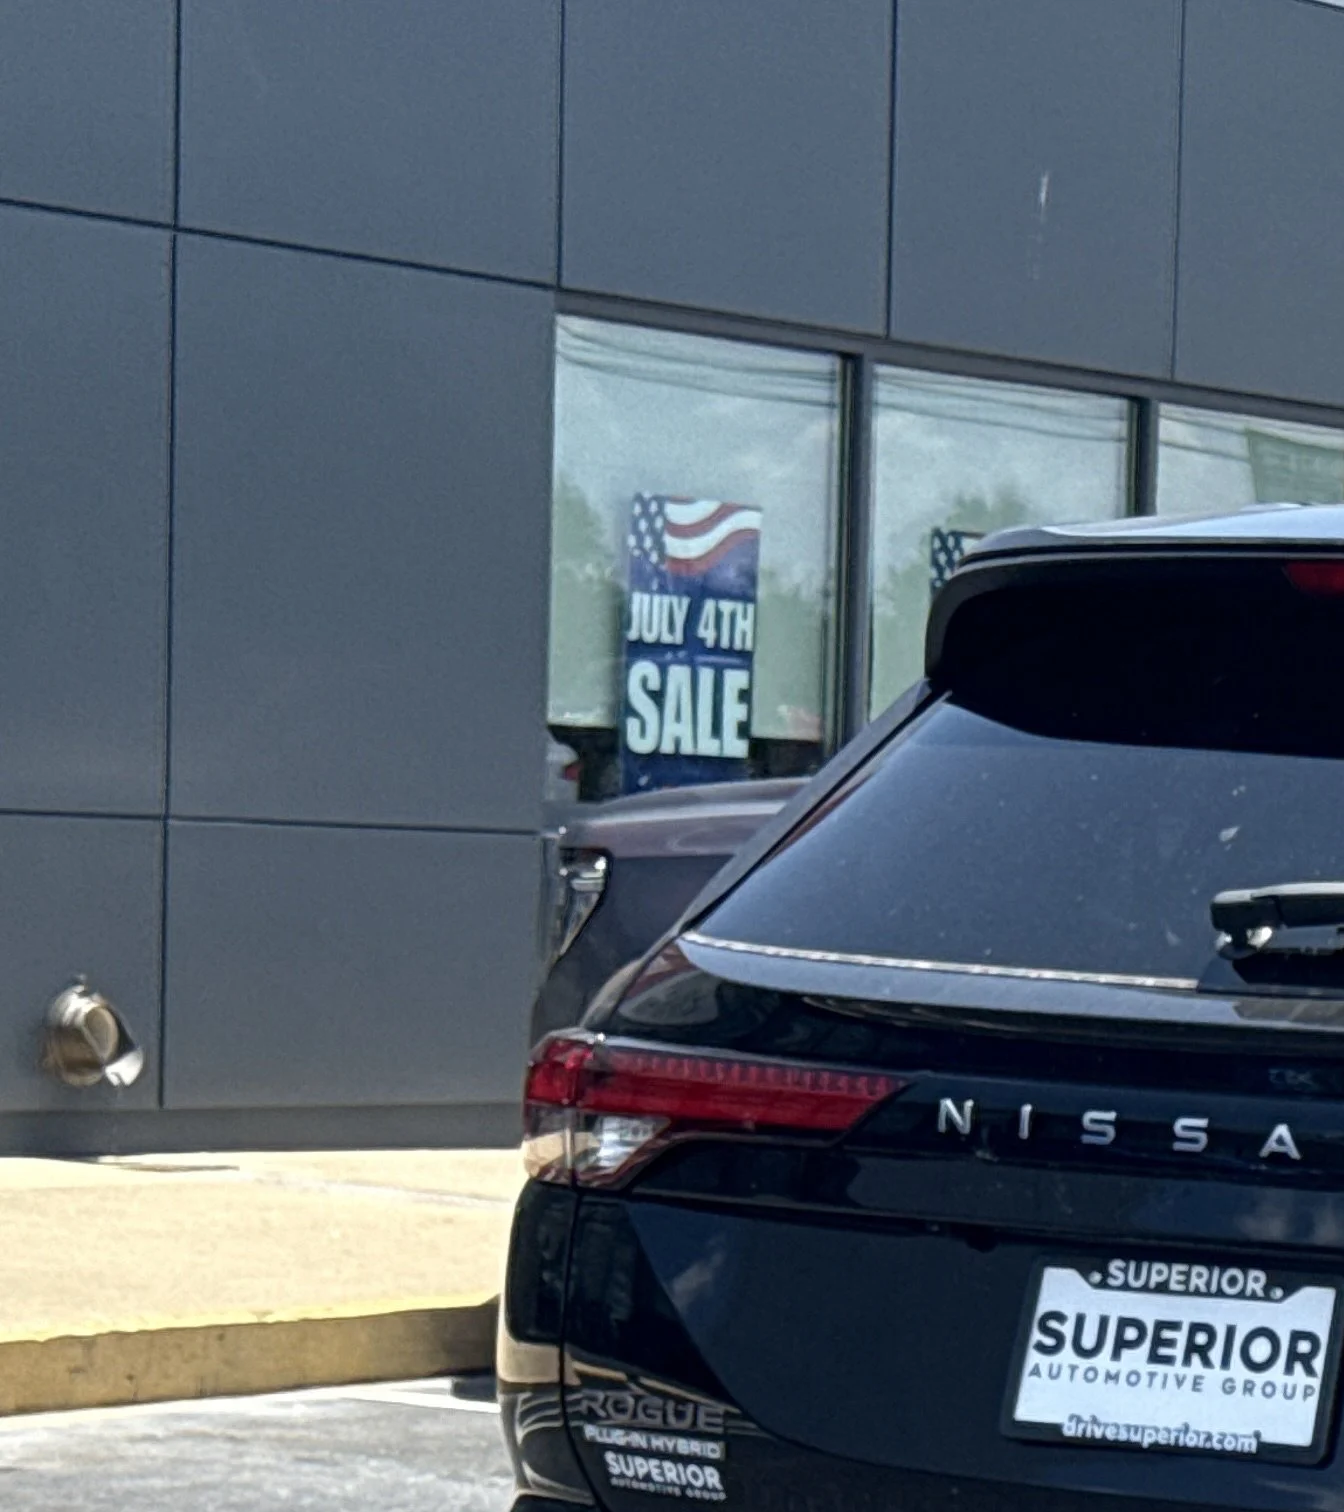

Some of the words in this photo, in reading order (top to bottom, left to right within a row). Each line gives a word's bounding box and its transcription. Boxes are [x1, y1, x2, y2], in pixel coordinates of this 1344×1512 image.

[627, 592, 690, 645] JULY
[697, 599, 754, 651] 4TH
[626, 661, 750, 759] SALE
[1107, 1258, 1267, 1298] SUPERIOR
[1033, 1310, 1321, 1377] SUPERIOR
[1028, 1362, 1205, 1393] AUTOMOTIVE
[1222, 1377, 1316, 1402] GROUP
[578, 1389, 726, 1434] ROGUE
[652, 1436, 722, 1460] HYBRID
[1062, 1413, 1262, 1454] drivesuperior.com
[604, 1451, 724, 1491] SUPERIOR
